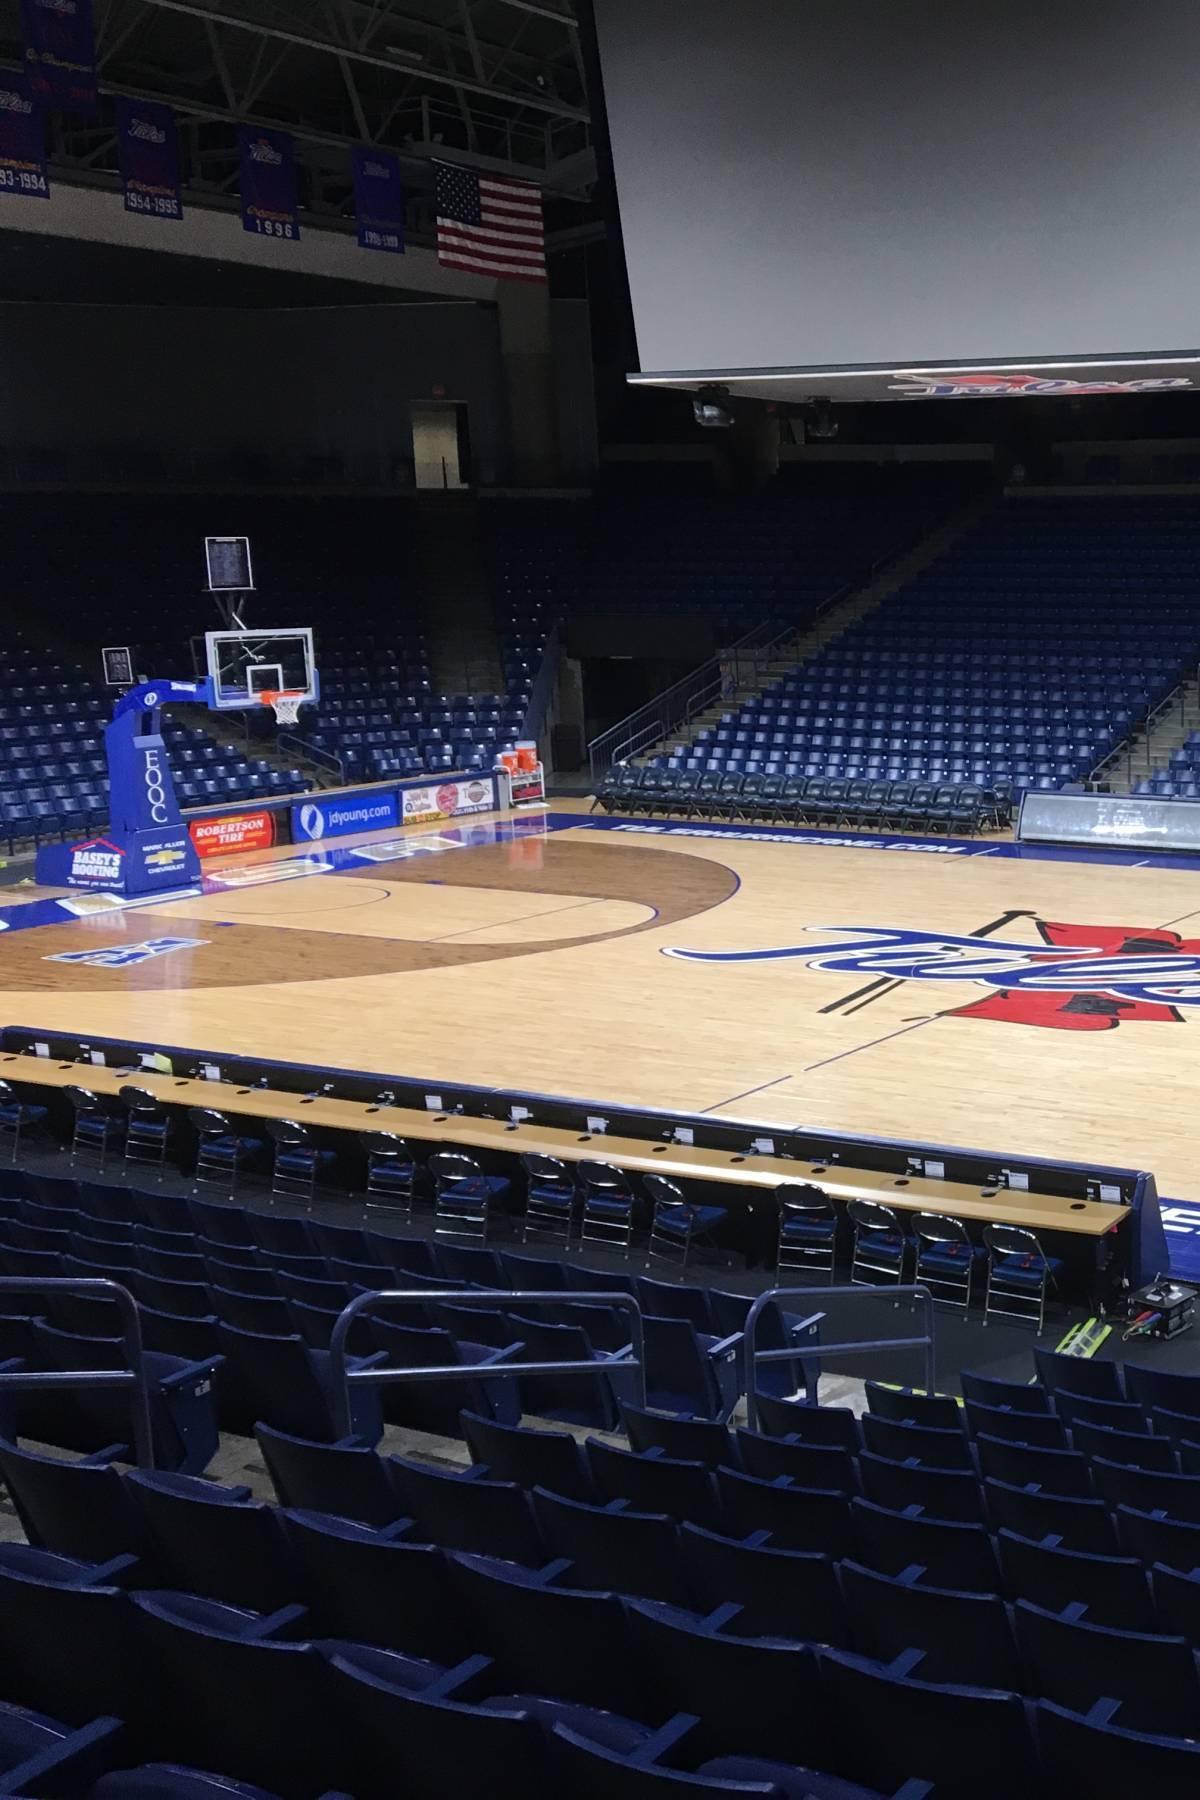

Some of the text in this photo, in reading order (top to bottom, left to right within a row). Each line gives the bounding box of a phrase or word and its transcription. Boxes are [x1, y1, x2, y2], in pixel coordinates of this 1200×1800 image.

[255, 218, 293, 238] 1996
[328, 805, 391, 827] jdyoung.com
[196, 819, 264, 838] ROBERTSON
[218, 831, 245, 844] TIRE
[71, 863, 120, 878] ROOFING
